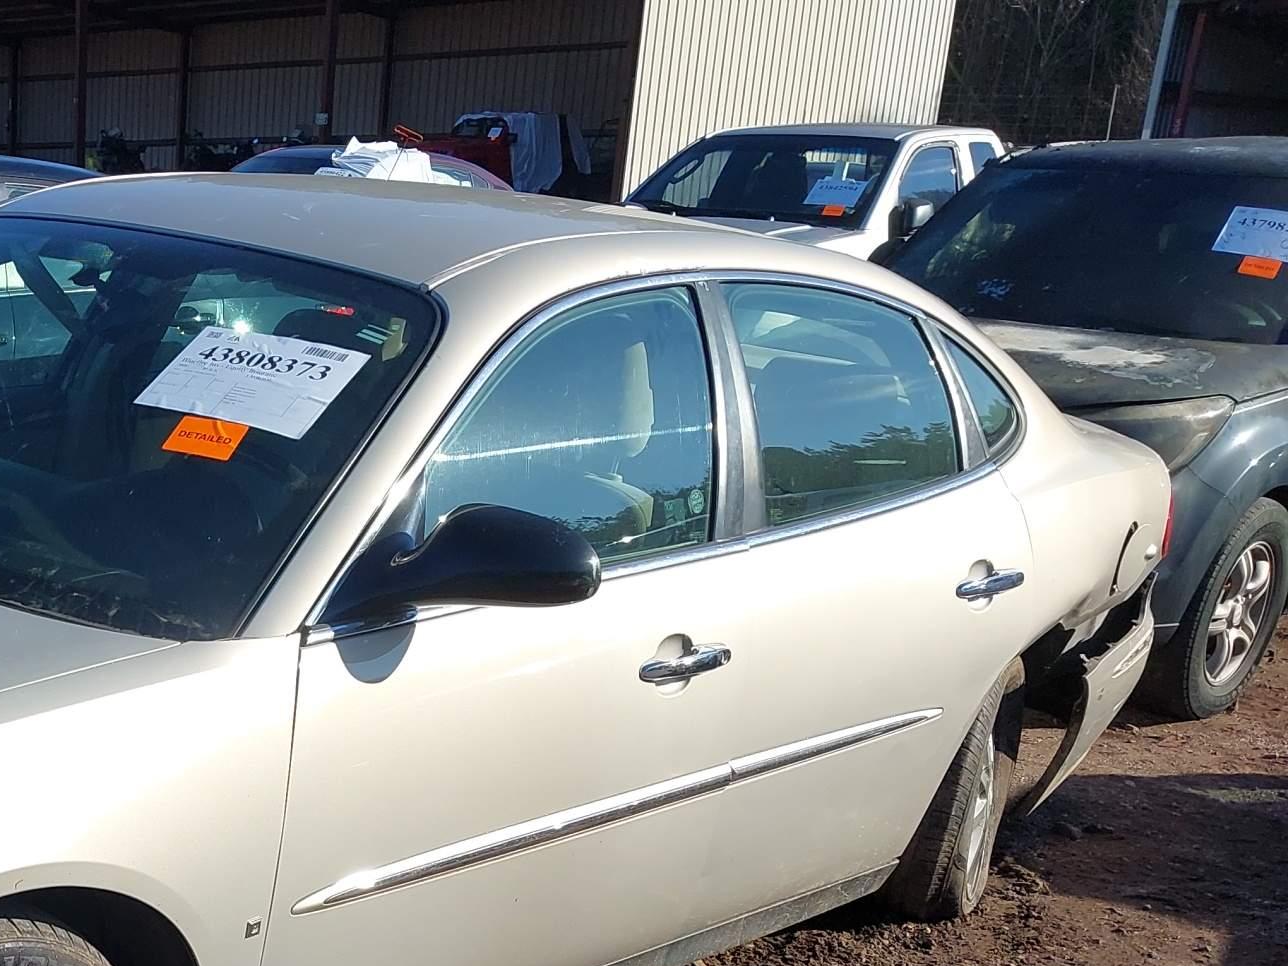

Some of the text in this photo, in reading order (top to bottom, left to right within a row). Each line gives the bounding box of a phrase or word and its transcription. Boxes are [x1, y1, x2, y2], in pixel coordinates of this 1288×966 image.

[1237, 217, 1288, 232] 43798
[198, 345, 332, 381] 43808373
[178, 430, 233, 445] DETAILED
